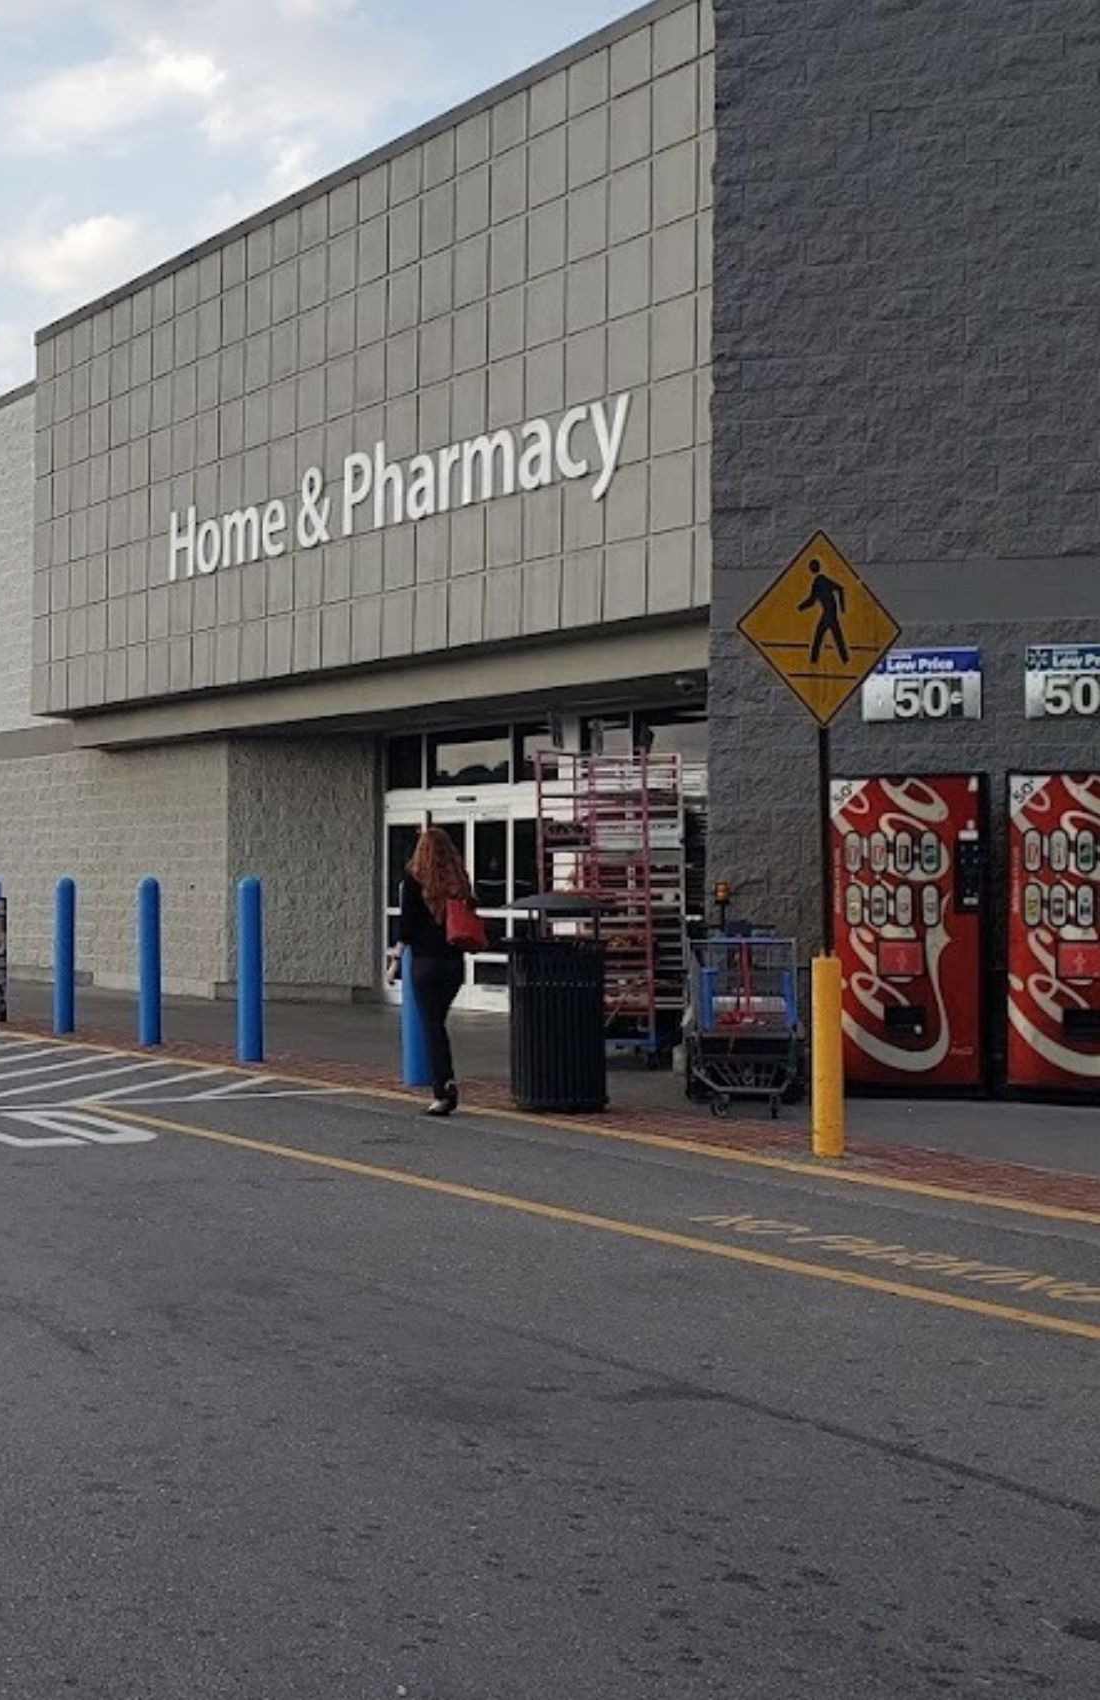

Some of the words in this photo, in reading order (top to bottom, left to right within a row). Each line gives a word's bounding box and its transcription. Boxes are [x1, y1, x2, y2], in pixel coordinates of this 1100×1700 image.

[168, 499, 286, 581] Home
[296, 466, 331, 549] &
[342, 393, 630, 536] Pharmacy
[885, 659, 917, 672] Low
[918, 655, 954, 671] Price
[1052, 653, 1083, 668] Low
[1044, 676, 1100, 715] 50
